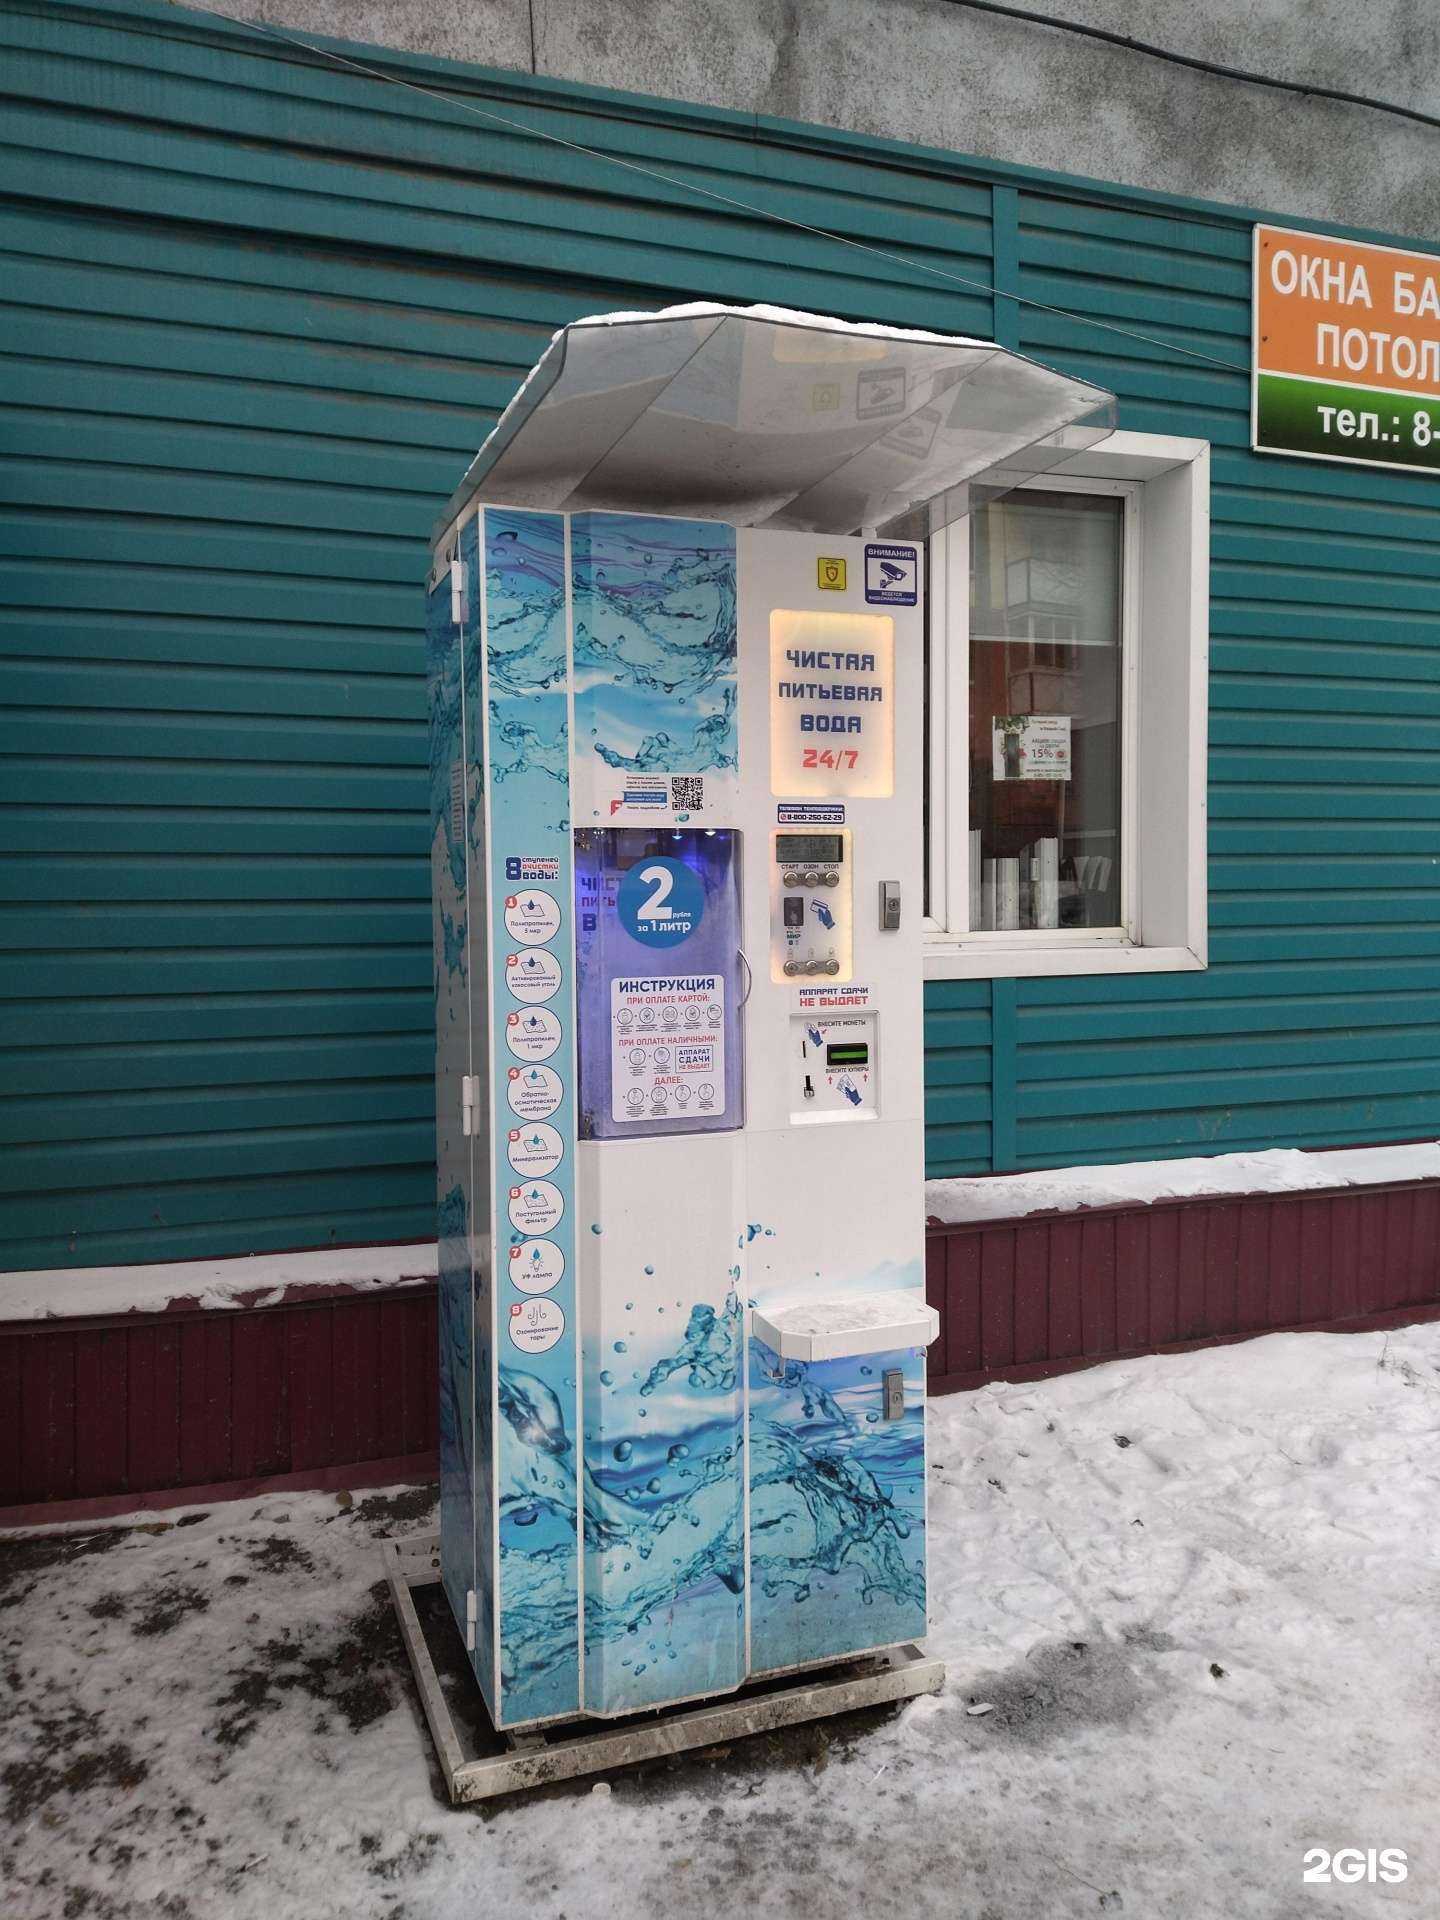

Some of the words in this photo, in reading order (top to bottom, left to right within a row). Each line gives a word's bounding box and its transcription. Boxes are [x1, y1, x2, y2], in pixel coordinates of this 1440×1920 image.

[1271, 250, 1374, 310] ОКНА
[1394, 271, 1440, 320] БА
[1317, 322, 1440, 383] ПОТОЛ
[1317, 405, 1400, 442] тел.:
[868, 548, 915, 558] ВНИМАНИЕ!
[786, 650, 875, 671] ЧИСТАЯ
[778, 682, 882, 702] ПИТЬЕВАЯ
[800, 714, 862, 733] ВОДА
[802, 749, 859, 770] 24/7
[1032, 749, 1054, 758] 15%
[506, 857, 521, 880] 8
[522, 870, 558, 880] воды:
[637, 865, 674, 920] 2
[673, 911, 691, 919] рубля
[650, 920, 657, 932] 1
[659, 921, 692, 933] литр
[619, 978, 715, 993] ИНСТРУКЦИЯ
[799, 988, 838, 996] АППАРАТ
[841, 987, 869, 995] СДАЧИ
[626, 997, 643, 1005] ПРИ
[645, 995, 675, 1004] ОПЛАТЕ
[677, 993, 711, 1003] КАРТОЙ:
[800, 997, 815, 1007] НЕ
[819, 996, 869, 1006] ВЫДАЕТ
[618, 1039, 634, 1047] ПРИ
[636, 1037, 665, 1046] ОПЛАТЕ
[678, 1048, 710, 1056] АППАРАТ
[679, 1055, 710, 1064] СДАЧИ
[654, 1076, 684, 1085] ДАЛЕЕ:
